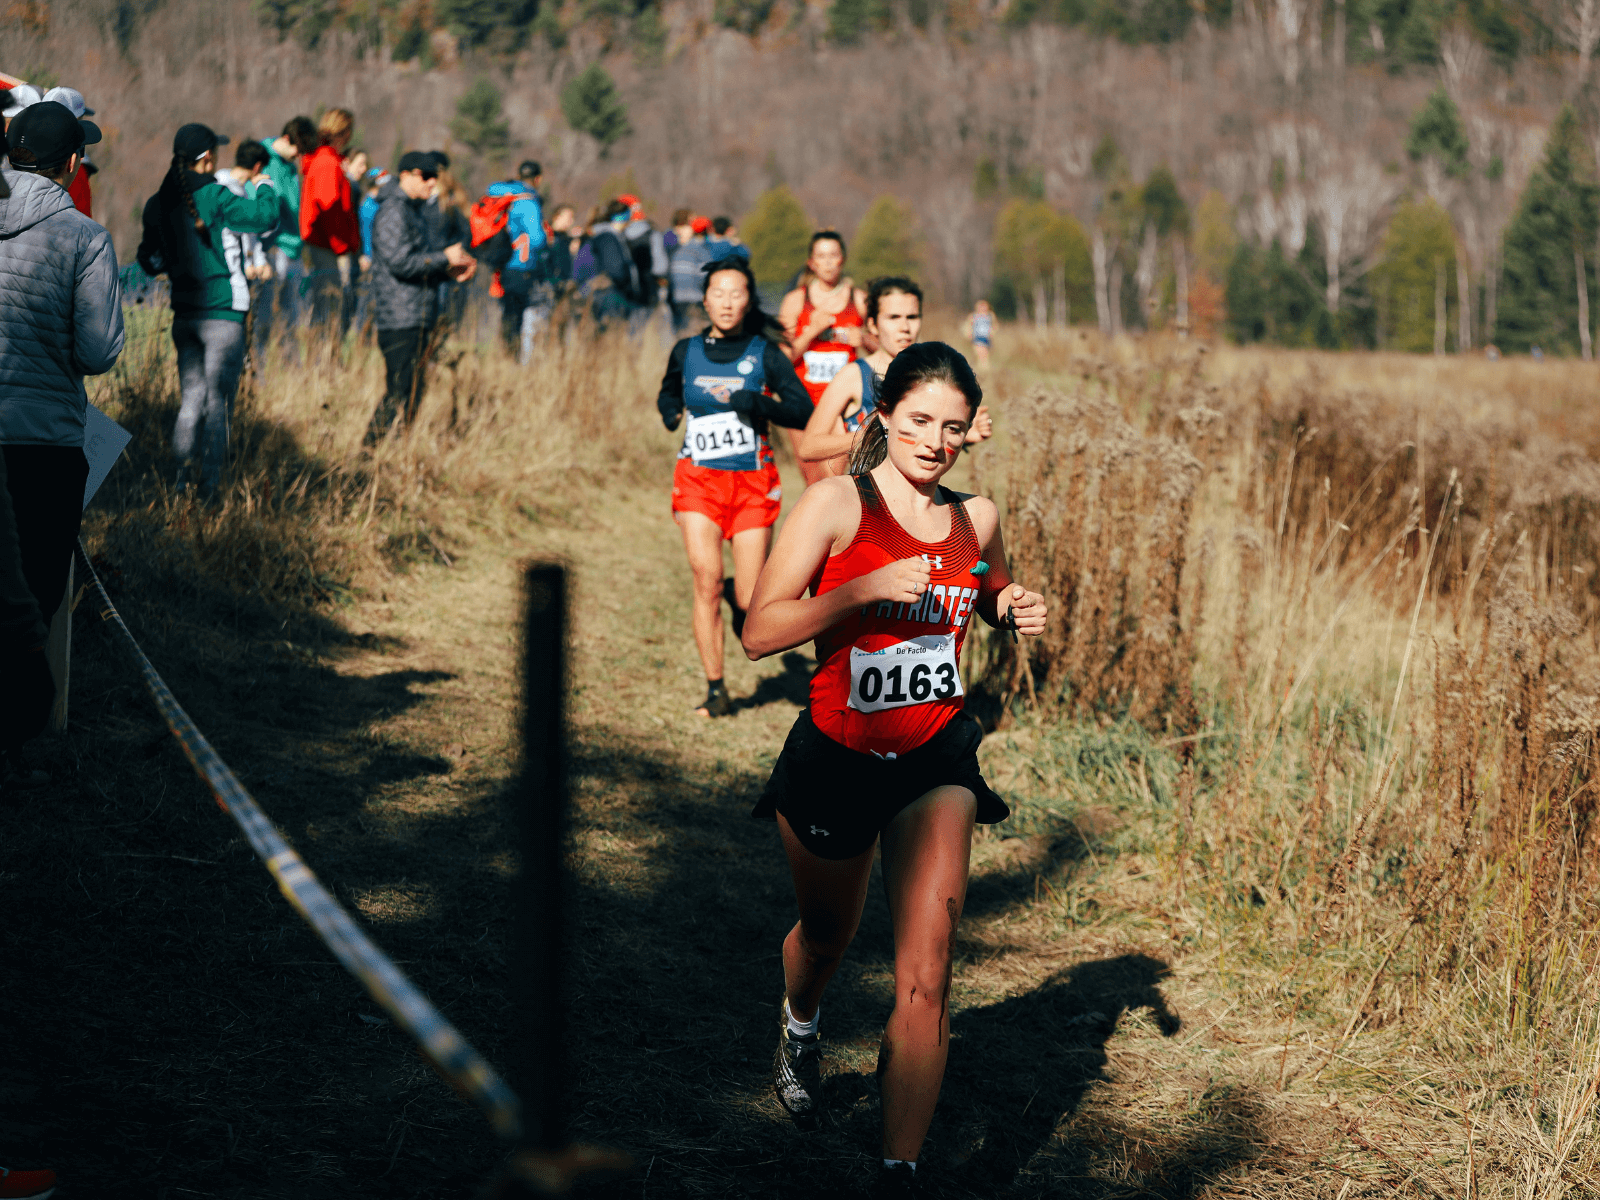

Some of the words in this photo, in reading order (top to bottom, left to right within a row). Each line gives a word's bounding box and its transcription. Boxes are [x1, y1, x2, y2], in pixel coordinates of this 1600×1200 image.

[695, 428, 749, 451] 0141
[861, 583, 979, 627] ARIOTES
[896, 647, 906, 655] De
[907, 646, 927, 655] Facto
[858, 662, 956, 703] 0163
